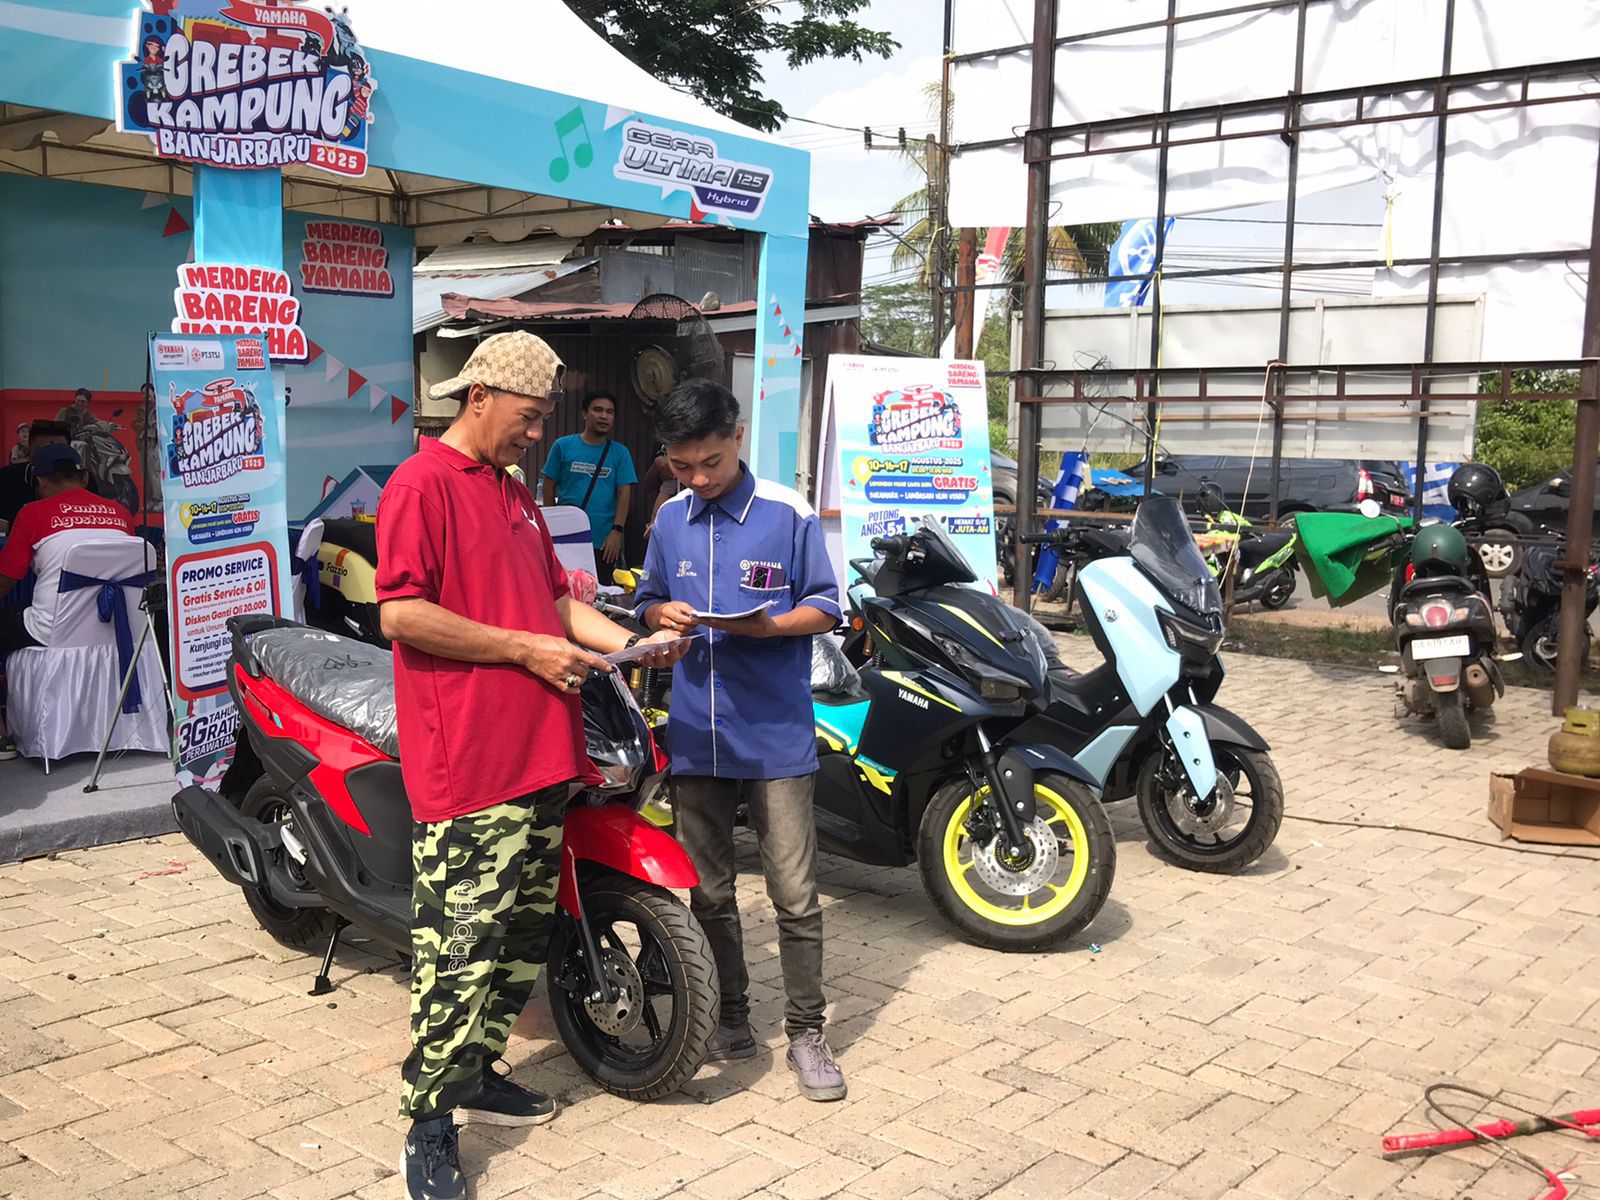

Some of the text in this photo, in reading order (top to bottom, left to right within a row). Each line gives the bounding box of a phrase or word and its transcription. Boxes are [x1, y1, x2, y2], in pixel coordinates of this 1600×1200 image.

[255, 8, 307, 26] YAMAHA
[163, 33, 320, 97] GREBEK
[147, 75, 351, 136] KAMPUNG
[160, 129, 358, 169] BANJARBARU 2025
[627, 127, 714, 158] GEAR
[624, 146, 763, 189] ULTIMA 125
[706, 190, 750, 208] Hybrid
[306, 223, 380, 245] MERDEKA
[304, 241, 385, 268] BARENG
[186, 266, 288, 295] MERDEKA
[302, 264, 391, 292] YAMAHA
[183, 292, 297, 326] BARENG
[183, 412, 242, 455] GREBEK
[877, 412, 955, 444] KAMPUNG
[881, 407, 941, 433] GREBEK
[178, 418, 255, 472] KAMPUNG
[184, 457, 262, 485] BANJARBARU 2025
[911, 457, 943, 465] AGUSTUS
[933, 477, 977, 489] GRATIS
[51, 515, 128, 528] Agustusan
[59, 502, 117, 515] Panitia
[232, 511, 260, 523] GRATIS
[868, 509, 900, 522] POTONG
[182, 557, 263, 584] PROMO SERVICE
[326, 562, 348, 577] Fazzio
[183, 591, 212, 607] Gratis
[213, 585, 245, 601] Service
[246, 582, 253, 593] &
[254, 579, 266, 591] Oli
[184, 614, 211, 627] Diskon
[211, 607, 232, 620] Ganti
[233, 605, 243, 615] Oli
[243, 600, 267, 613] 20.000
[187, 623, 224, 637] untuk Umum
[190, 638, 222, 654] Kunjungi
[209, 703, 238, 722] TAHUN
[898, 688, 929, 710] YAMAHA
[186, 734, 235, 761] PERAWATAN
[447, 878, 480, 972] adidas
